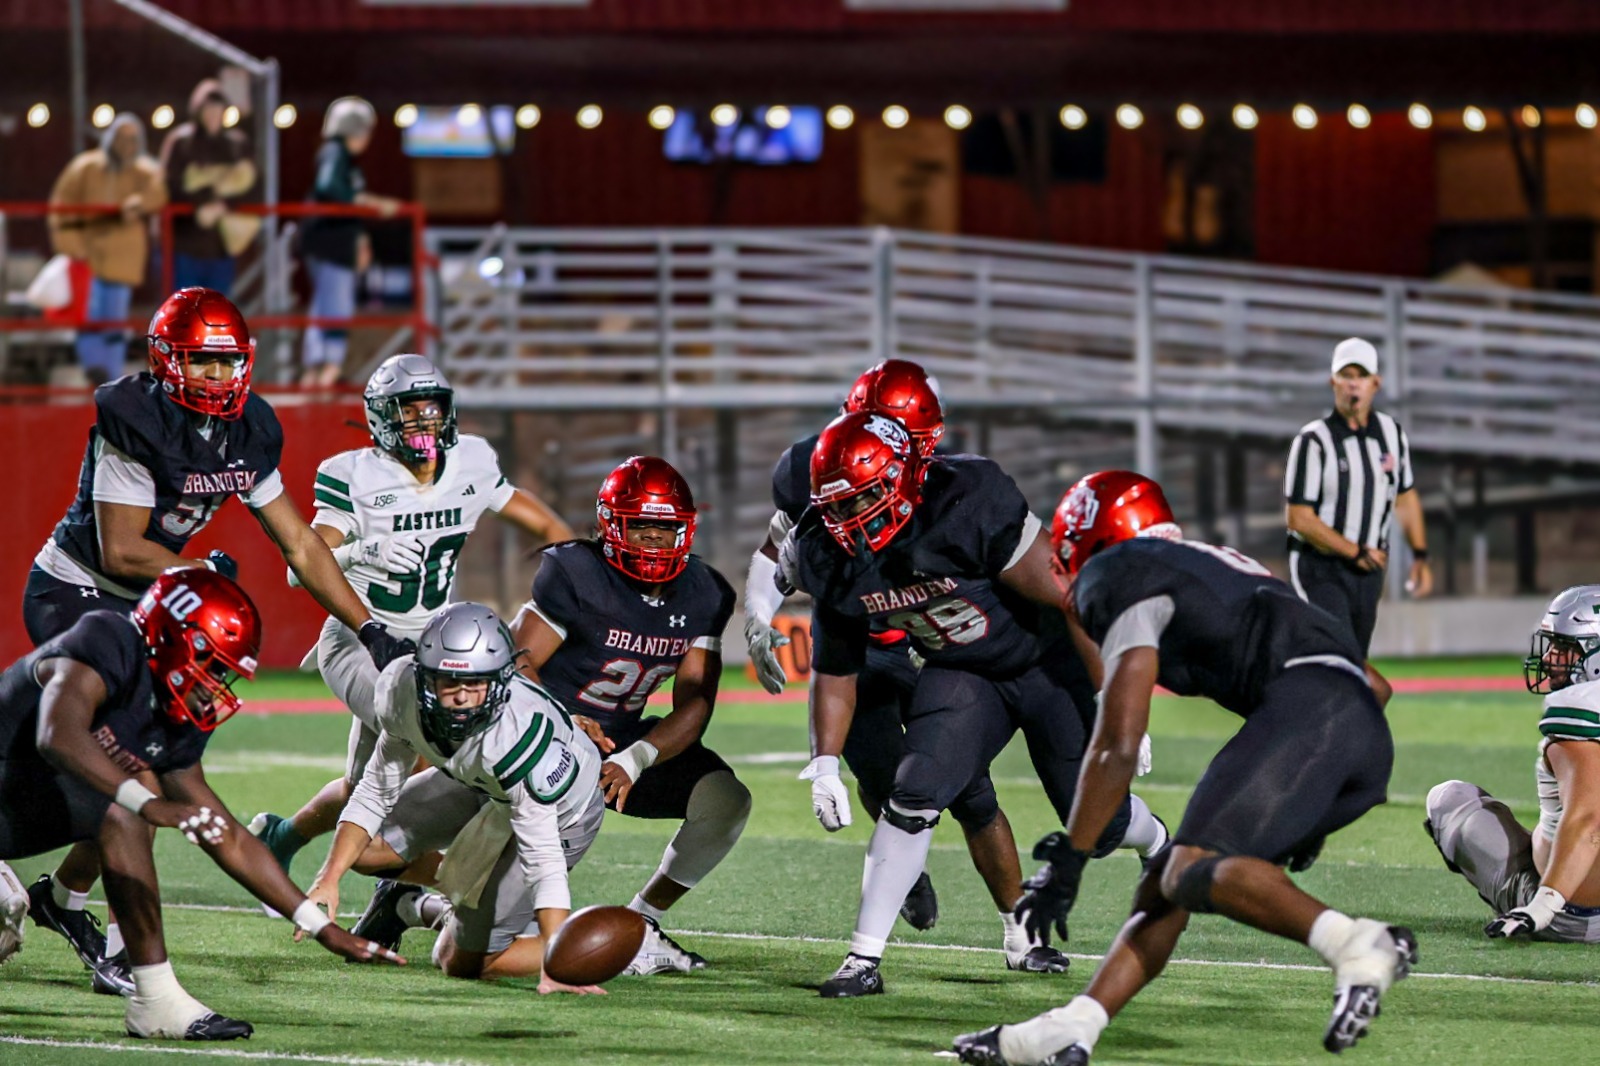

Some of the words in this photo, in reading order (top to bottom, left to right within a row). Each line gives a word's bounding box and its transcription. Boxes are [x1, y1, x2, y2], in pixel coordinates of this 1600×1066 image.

[392, 507, 462, 532] EASTERN
[160, 584, 203, 621] 10
[442, 661, 470, 669] Riddell
[546, 747, 571, 788] DOUGLAS
